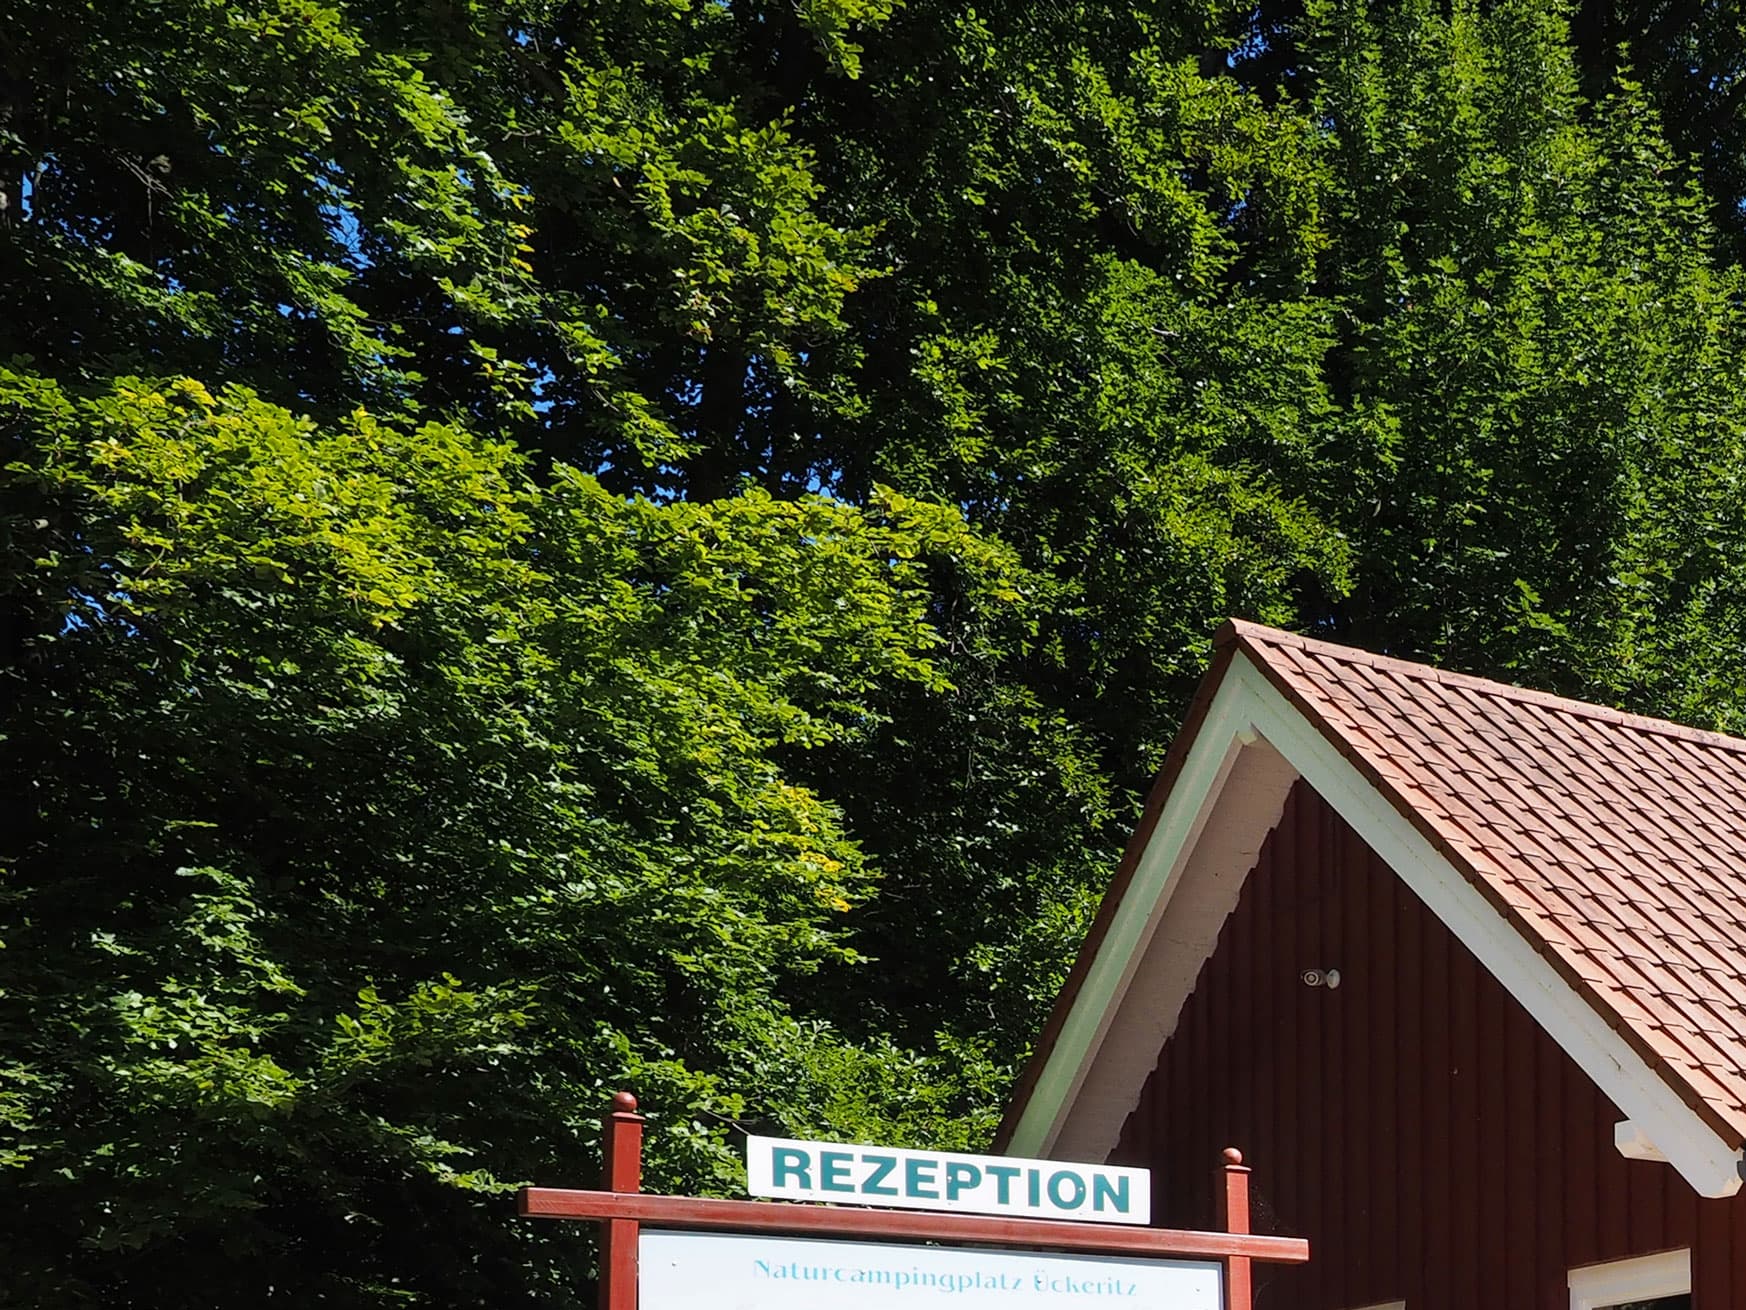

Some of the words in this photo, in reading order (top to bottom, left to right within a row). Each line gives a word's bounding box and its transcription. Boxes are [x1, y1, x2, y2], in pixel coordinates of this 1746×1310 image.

[772, 1146, 1130, 1213] REZEPTION
[754, 1259, 1022, 1293] Naturcampingplatz
[1034, 1273, 1137, 1297] Ückeritz
